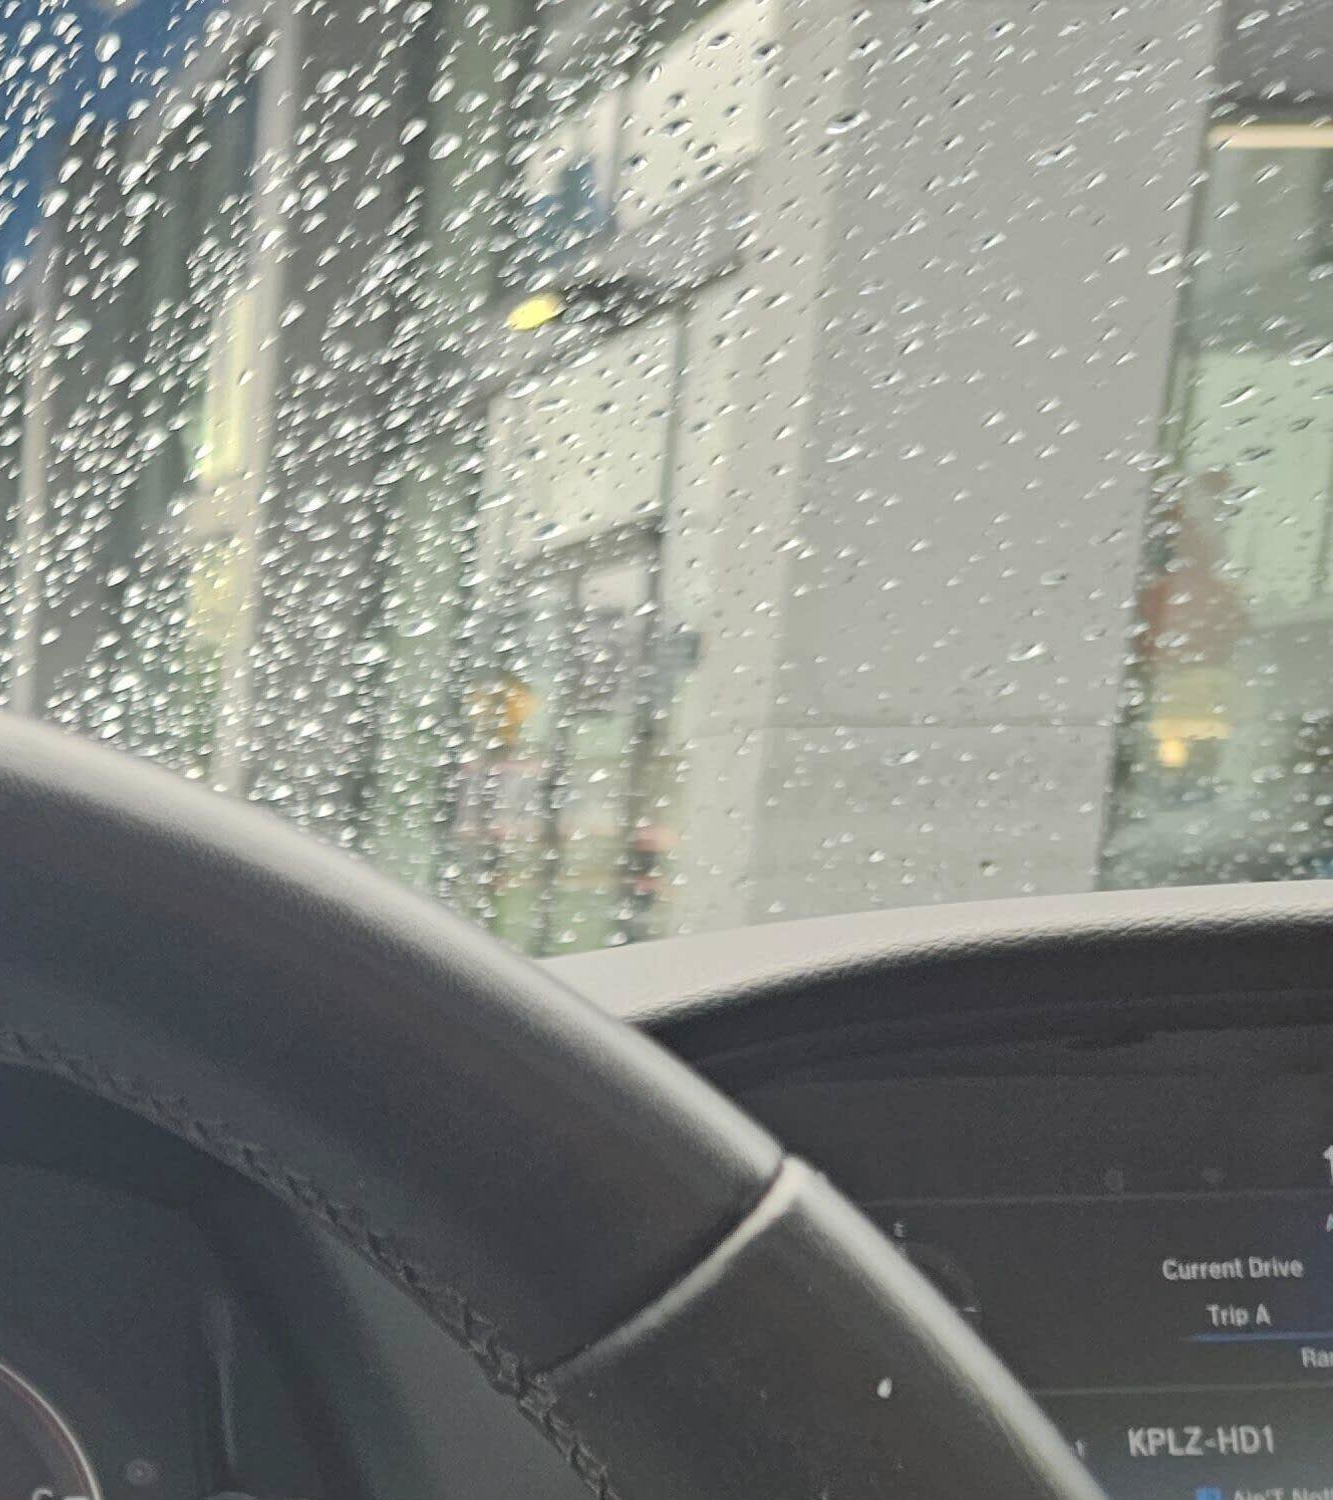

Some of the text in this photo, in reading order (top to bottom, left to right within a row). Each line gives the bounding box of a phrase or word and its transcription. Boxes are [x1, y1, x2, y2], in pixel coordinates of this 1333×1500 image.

[1163, 1256, 1305, 1280] Current Drive
[1206, 1303, 1272, 1327] Trip A
[1128, 1425, 1275, 1456] KPLZ-HD1
